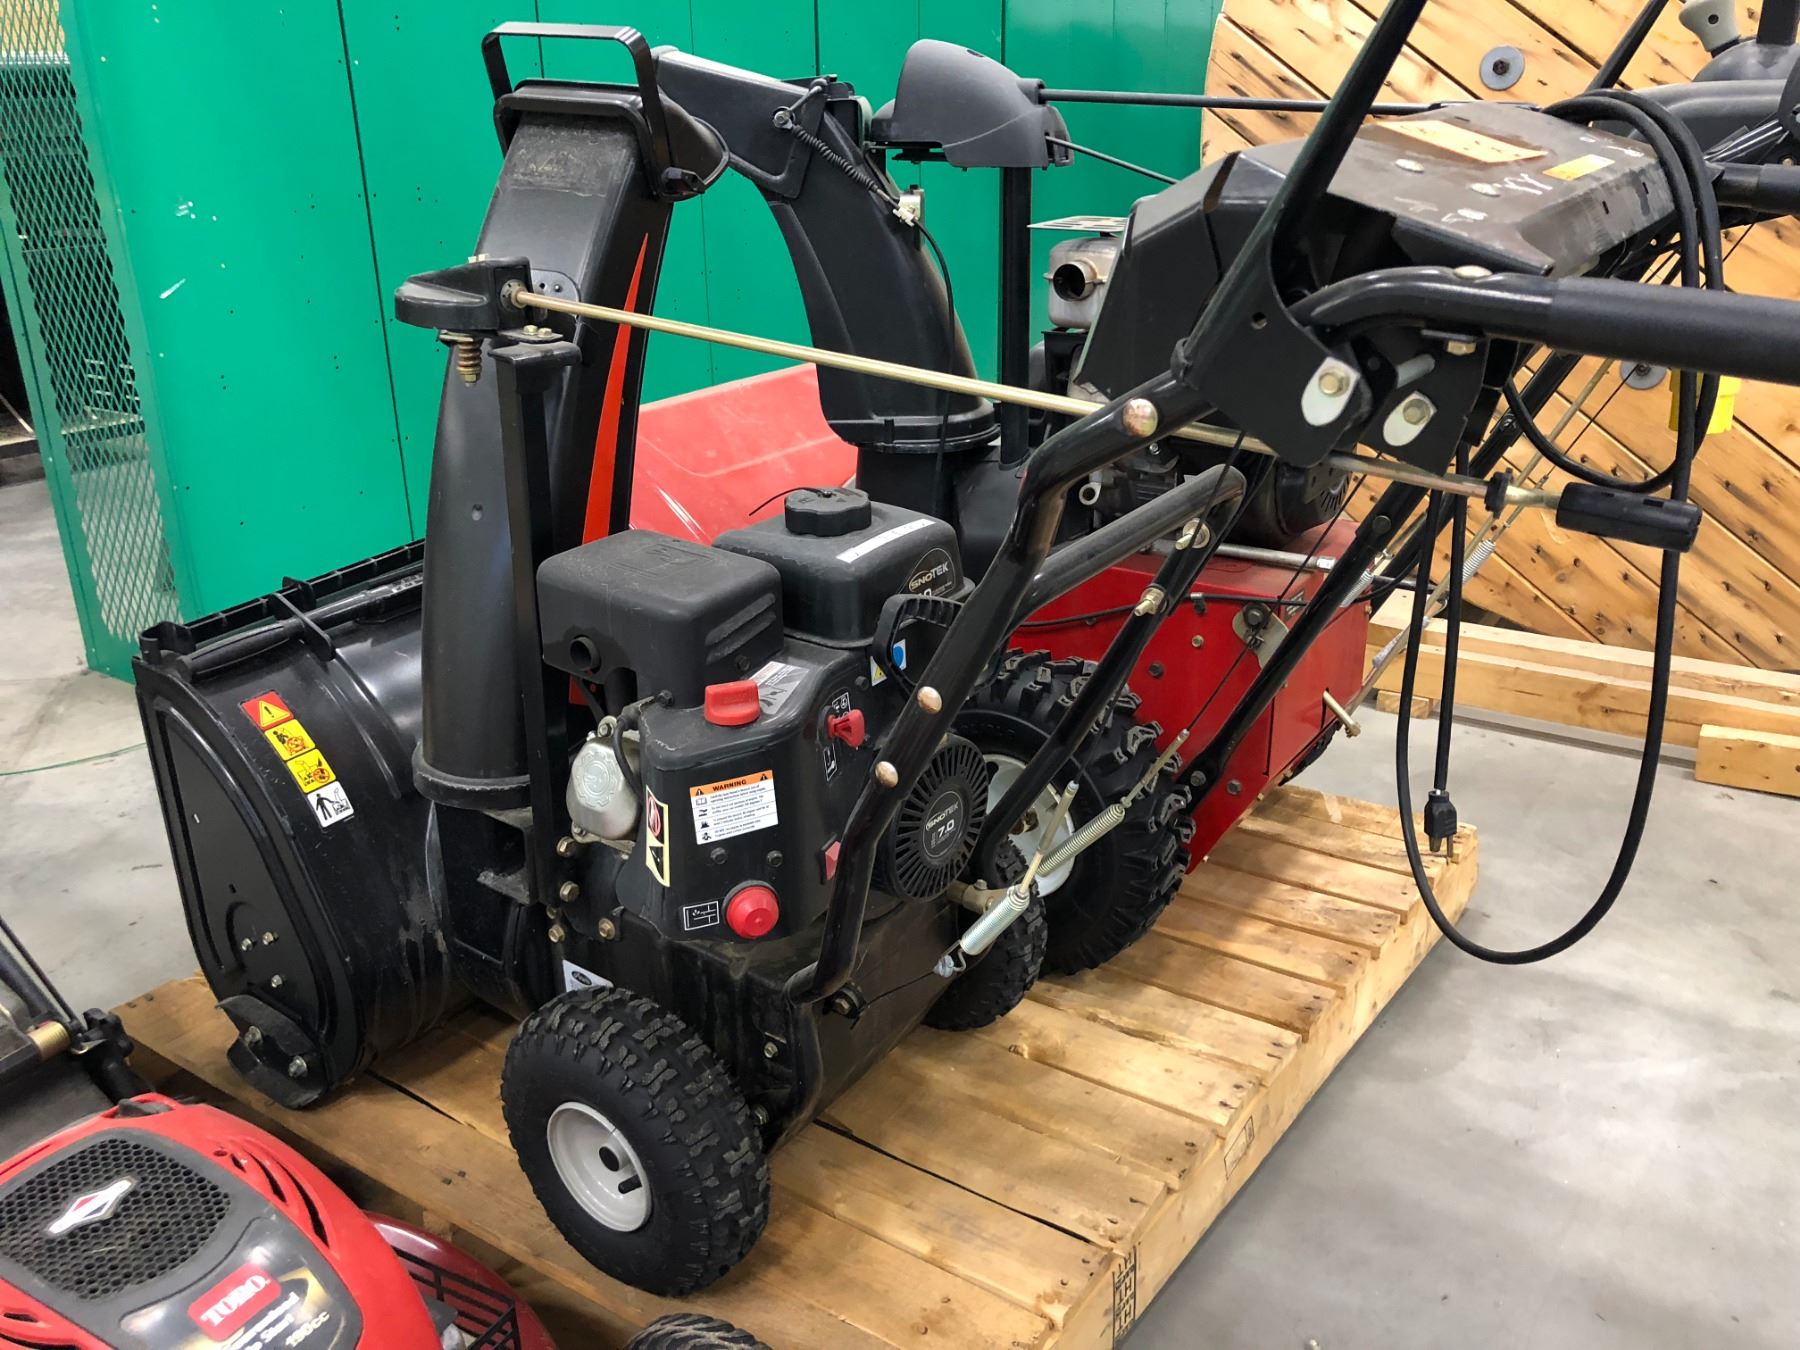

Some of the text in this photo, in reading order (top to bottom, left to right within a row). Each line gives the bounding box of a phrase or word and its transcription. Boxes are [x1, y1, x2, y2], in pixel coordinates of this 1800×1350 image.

[910, 561, 949, 590] SNOTEK
[712, 779, 747, 792] WARNING
[926, 800, 959, 829] SNOTEK
[937, 819, 955, 838] 7.0
